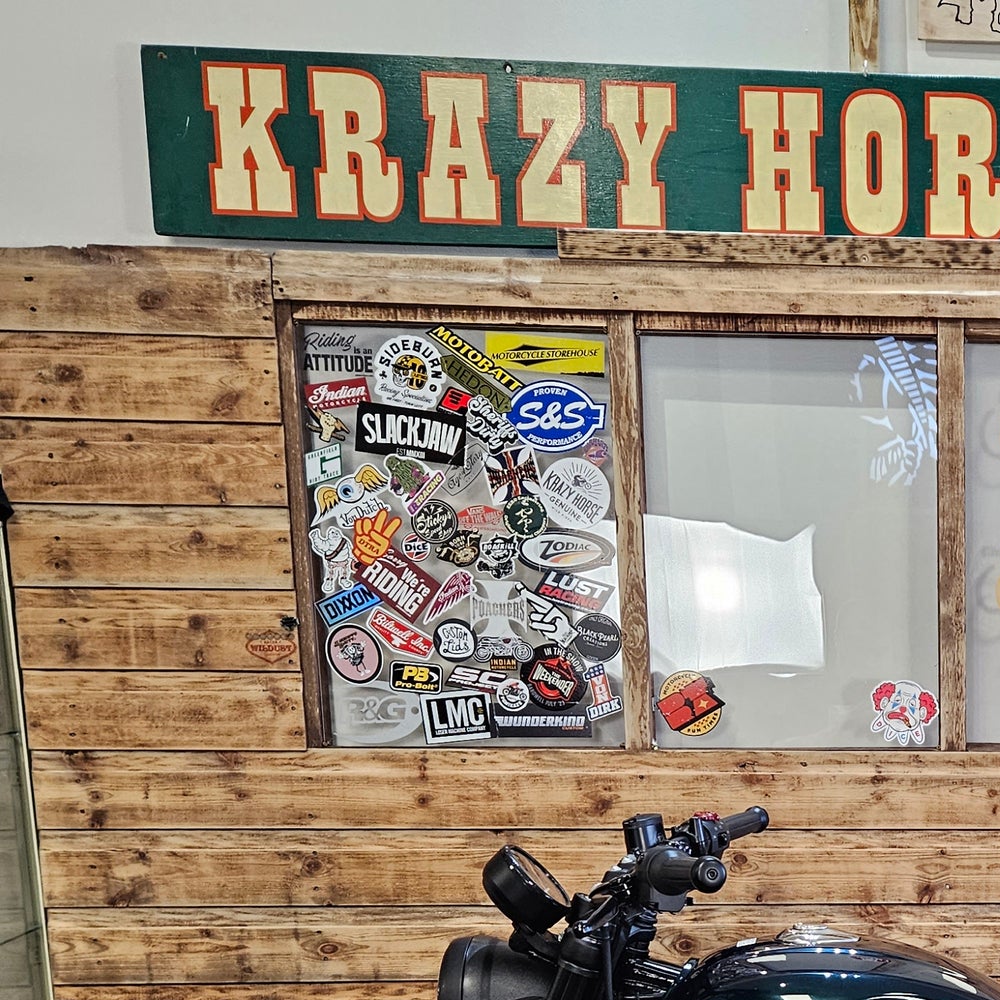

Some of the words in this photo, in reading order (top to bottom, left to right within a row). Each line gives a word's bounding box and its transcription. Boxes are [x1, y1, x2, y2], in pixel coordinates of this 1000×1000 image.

[202, 61, 677, 231] KRAZY
[304, 332, 356, 351] Riding
[303, 353, 373, 373] ATTITUDE
[378, 340, 442, 379] SIDEBURN
[433, 325, 522, 392] MOTOBATT
[491, 351, 545, 360] MOTORCYCLE
[546, 348, 599, 358] STOREHOUSE
[308, 384, 368, 404] Indian
[533, 387, 568, 397] PROVEN
[516, 401, 587, 430] S&S
[361, 413, 462, 456] SLACKJAW
[526, 431, 583, 446] PERFORMANCE
[357, 497, 388, 519] Dutch
[543, 470, 576, 501] KRAZY
[573, 493, 604, 525] HORSE
[549, 496, 581, 521] GENUINE
[359, 539, 380, 554] DTRA
[540, 540, 591, 560] ZODIAC
[361, 561, 421, 616] RIDING
[400, 566, 431, 598] We're
[543, 571, 610, 598] LUST
[323, 586, 375, 620] DIXXON
[539, 585, 600, 610] RACING
[443, 626, 468, 641] CUSTOM
[577, 626, 598, 639] BLACK
[443, 639, 469, 654] Lids
[544, 647, 552, 656] IN
[552, 647, 567, 658] THE
[566, 650, 584, 673] SHOW
[402, 665, 430, 682] PB
[532, 663, 574, 698] WEEKENDER
[395, 680, 438, 691] Pro-Bolt
[430, 697, 484, 729] LMC
[590, 699, 621, 719] DIRK
[495, 715, 585, 728] WUNDERKIND
[703, 712, 718, 729] TIMES
